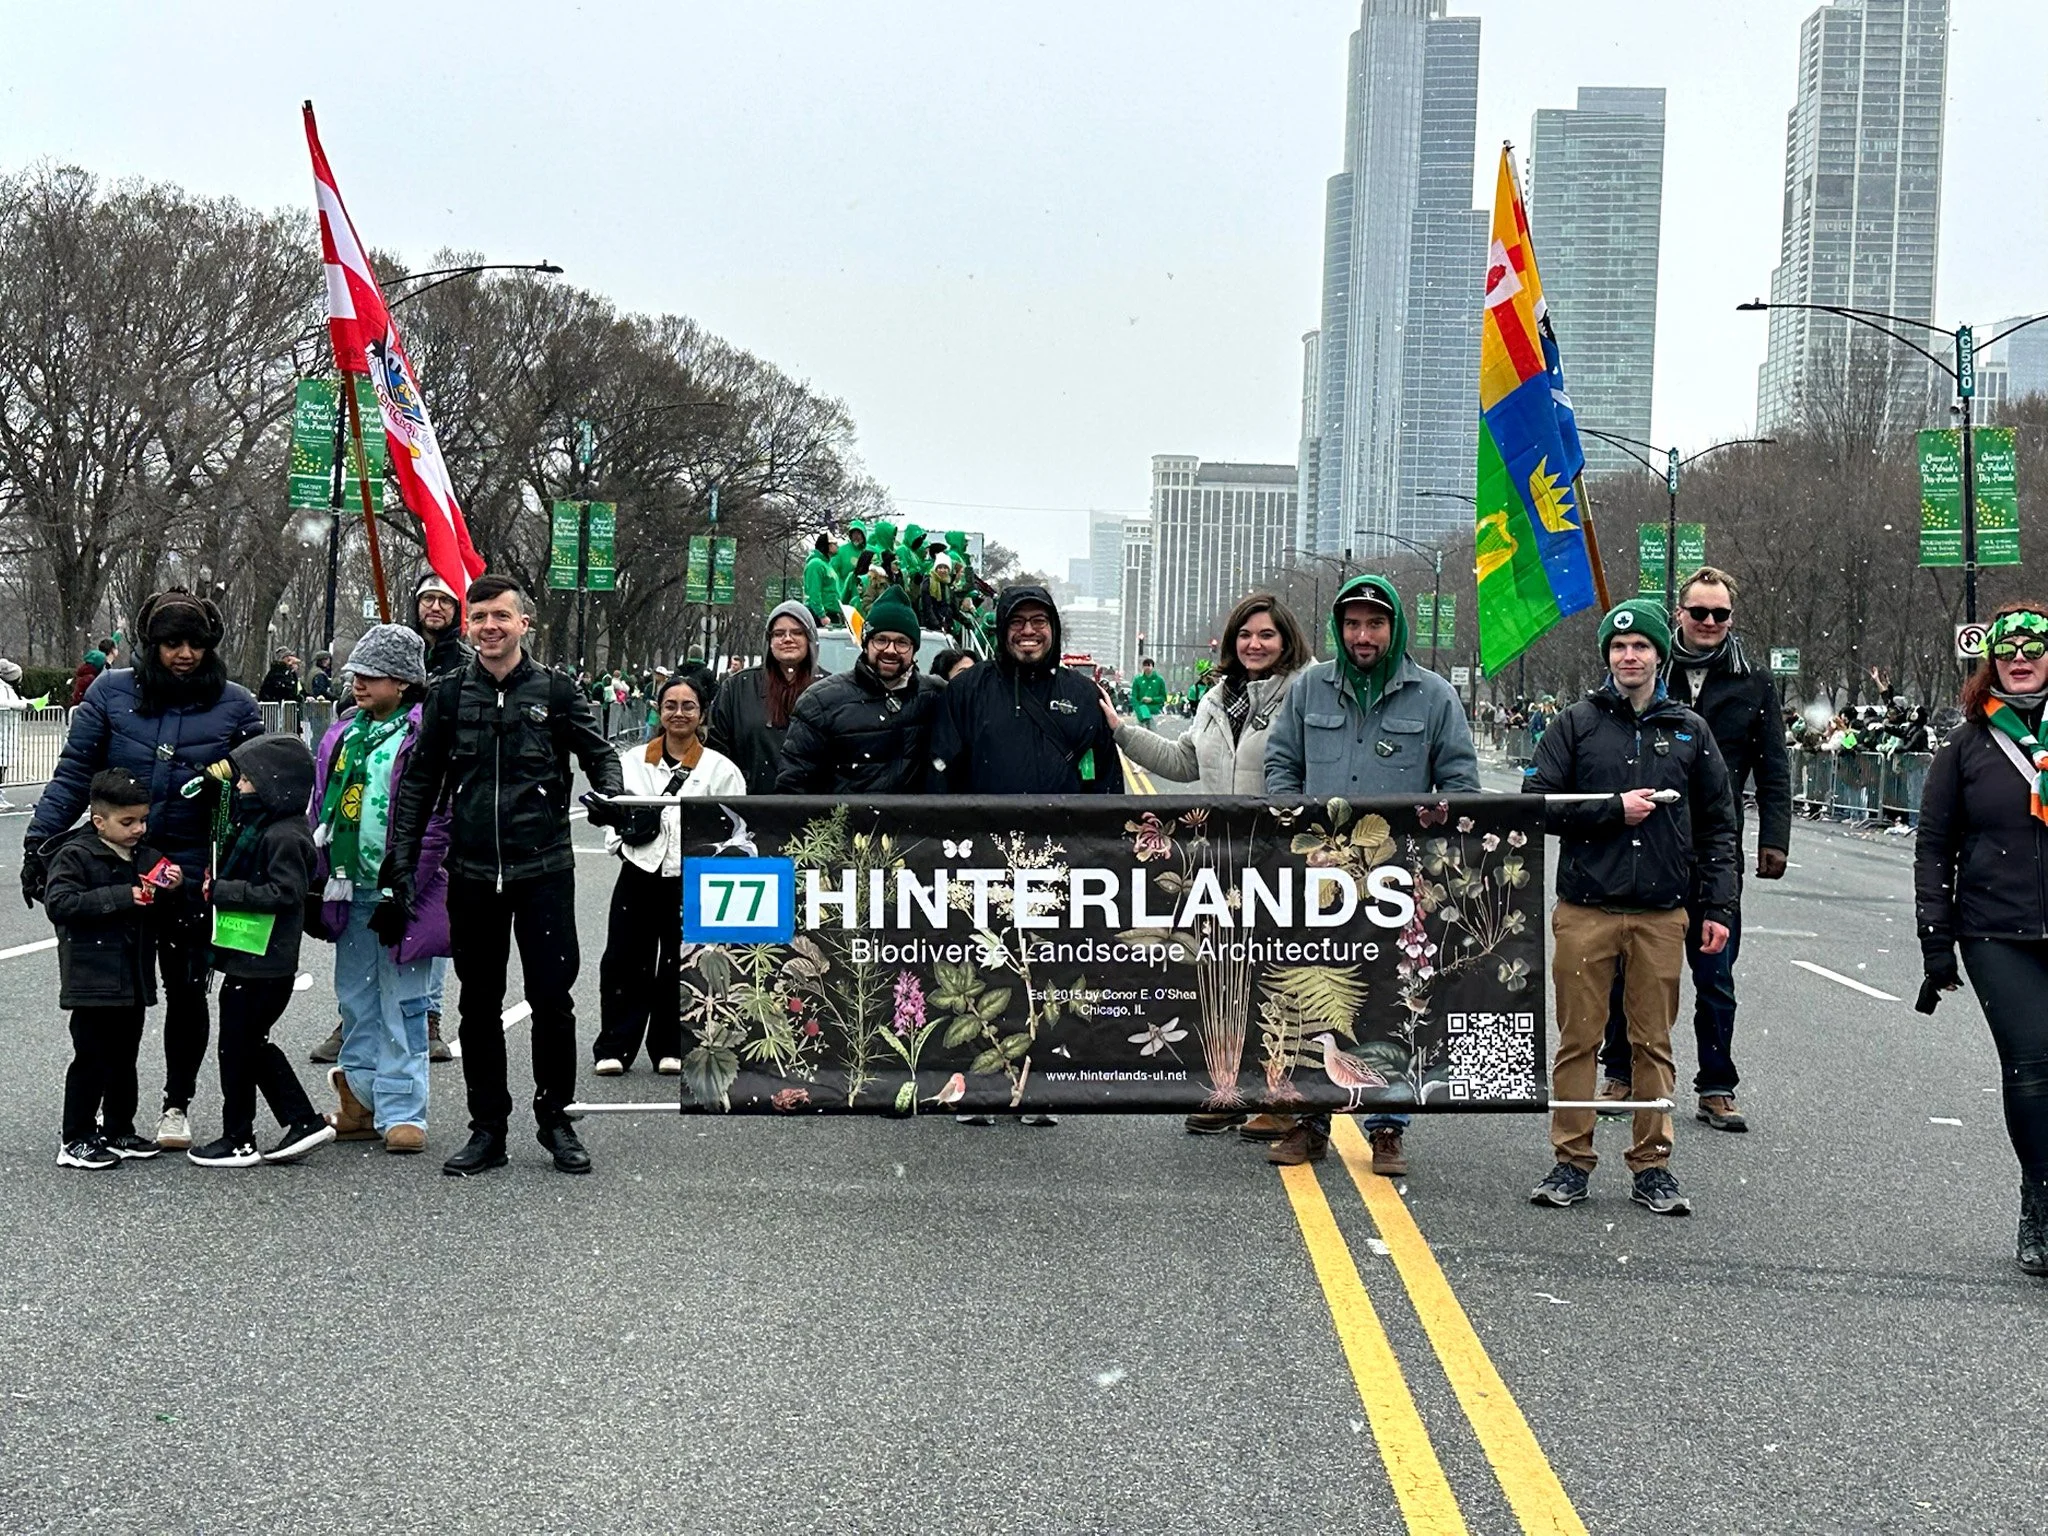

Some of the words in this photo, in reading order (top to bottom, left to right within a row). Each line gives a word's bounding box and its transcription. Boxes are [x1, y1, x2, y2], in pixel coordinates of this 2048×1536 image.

[1958, 335, 1972, 389] C530
[708, 880, 766, 922] 77
[805, 865, 1416, 931] HINTERLANDS
[851, 938, 1009, 964] Biodiverse
[1022, 938, 1186, 968] Landscape
[1195, 938, 1380, 963] Architecture
[1053, 989, 1082, 1001] 2015
[1085, 989, 1099, 1002] by
[1102, 989, 1137, 1001] Conor
[1140, 988, 1152, 1000] E.
[1154, 988, 1197, 1000] O'Shea
[1081, 1004, 1131, 1017] Chicago,
